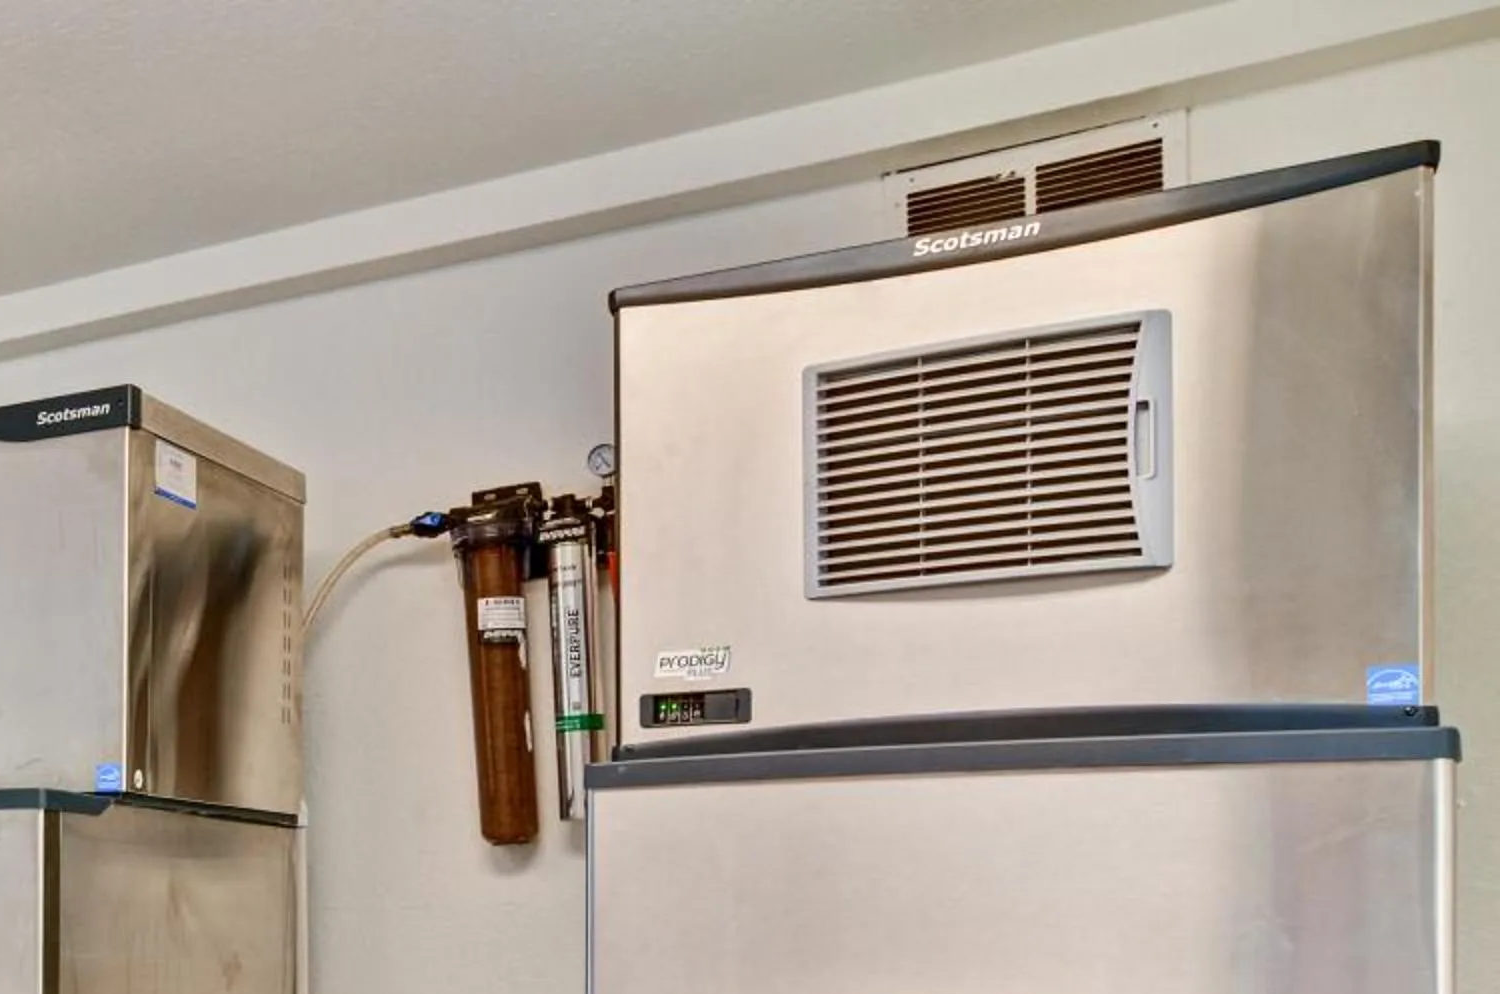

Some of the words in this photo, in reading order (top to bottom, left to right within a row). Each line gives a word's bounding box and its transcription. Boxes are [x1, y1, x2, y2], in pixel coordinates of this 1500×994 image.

[912, 222, 1041, 257] Scotsman
[36, 403, 111, 425] Scotsman
[567, 608, 582, 679] EVERPURE
